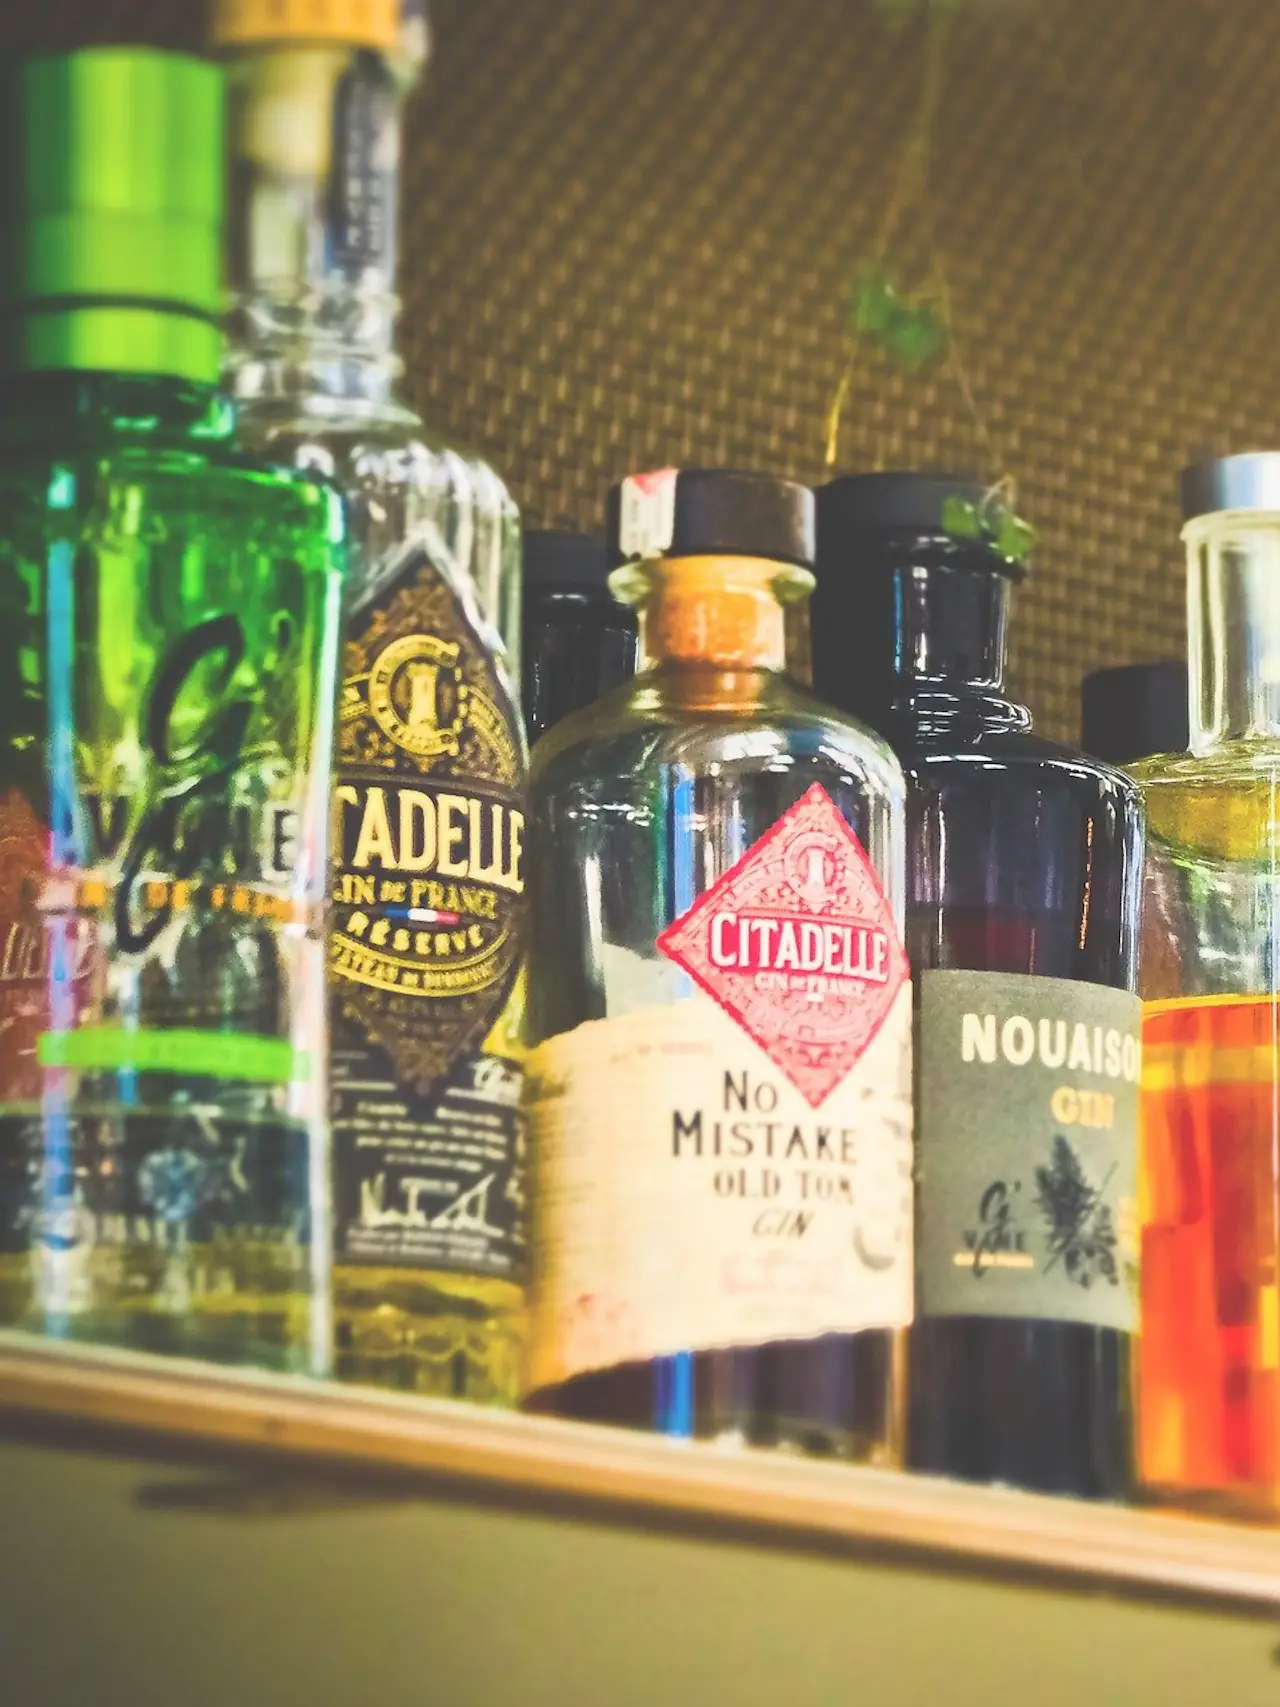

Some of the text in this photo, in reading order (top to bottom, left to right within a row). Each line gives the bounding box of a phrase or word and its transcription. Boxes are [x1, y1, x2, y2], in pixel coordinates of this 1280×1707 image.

[333, 785, 525, 894] TADELLE
[711, 911, 889, 985] CITADELLE
[1051, 1086, 1115, 1129] GIN
[671, 1109, 859, 1166] MISTAKE
[712, 1168, 781, 1199] OLD
